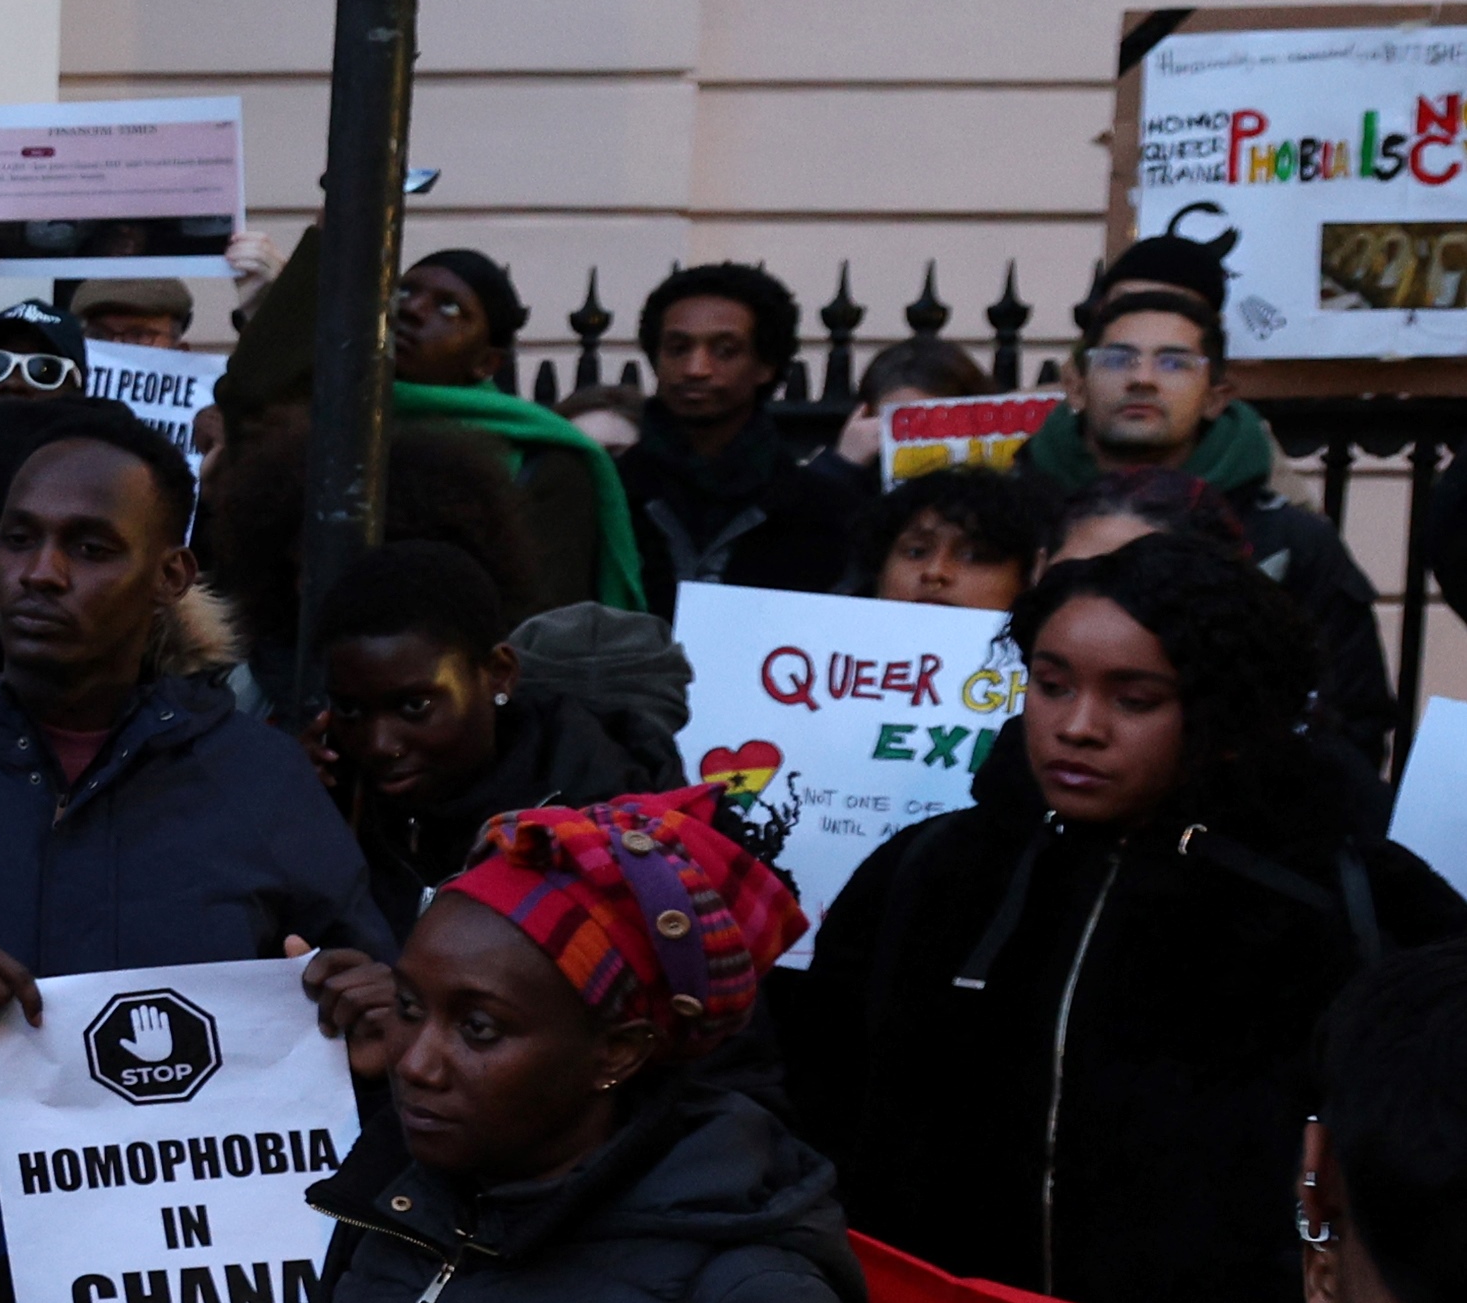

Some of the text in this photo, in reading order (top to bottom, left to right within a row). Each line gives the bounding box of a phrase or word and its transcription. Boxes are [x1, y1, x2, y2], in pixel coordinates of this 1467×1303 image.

[116, 369, 197, 409] PEOPLE
[760, 645, 943, 711] QUEER
[120, 1062, 193, 1087] STOP
[18, 1127, 340, 1196] HOMOPHOBIA
[161, 1204, 213, 1250] IN
